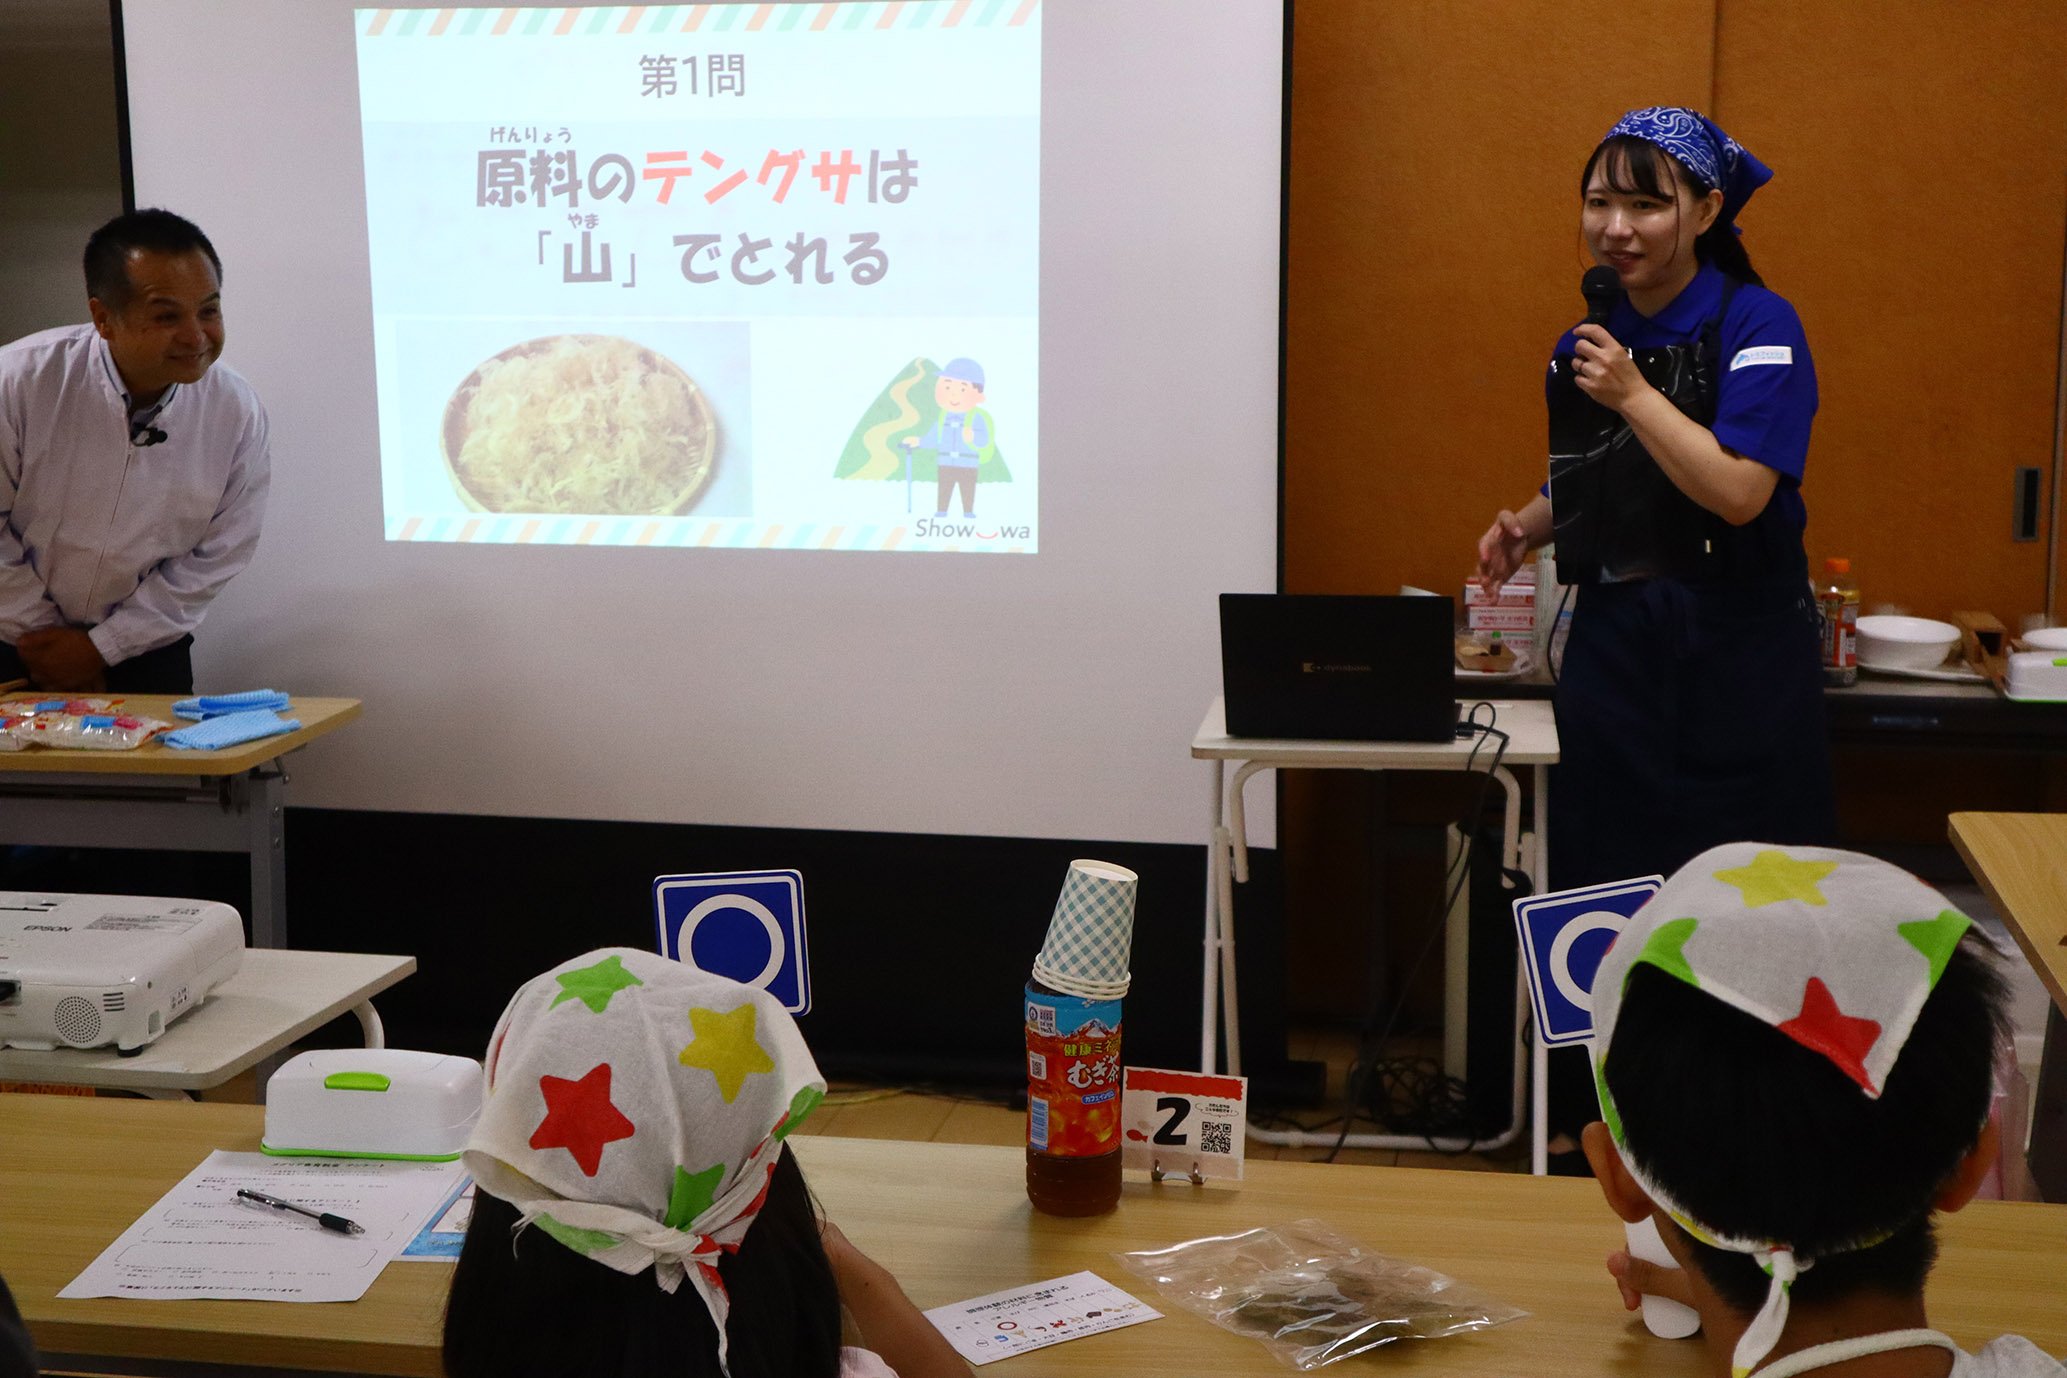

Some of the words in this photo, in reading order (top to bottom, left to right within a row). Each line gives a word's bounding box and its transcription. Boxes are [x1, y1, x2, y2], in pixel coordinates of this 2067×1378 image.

[638, 53, 745, 99] 第1問
[489, 125, 573, 144] げんりょう
[475, 148, 919, 208] 原料のテングサは
[567, 212, 600, 230] やま
[23, 924, 73, 933] EPSON
[1066, 1050, 1120, 1089] むぎ茶
[1152, 1096, 1191, 1146] 2
